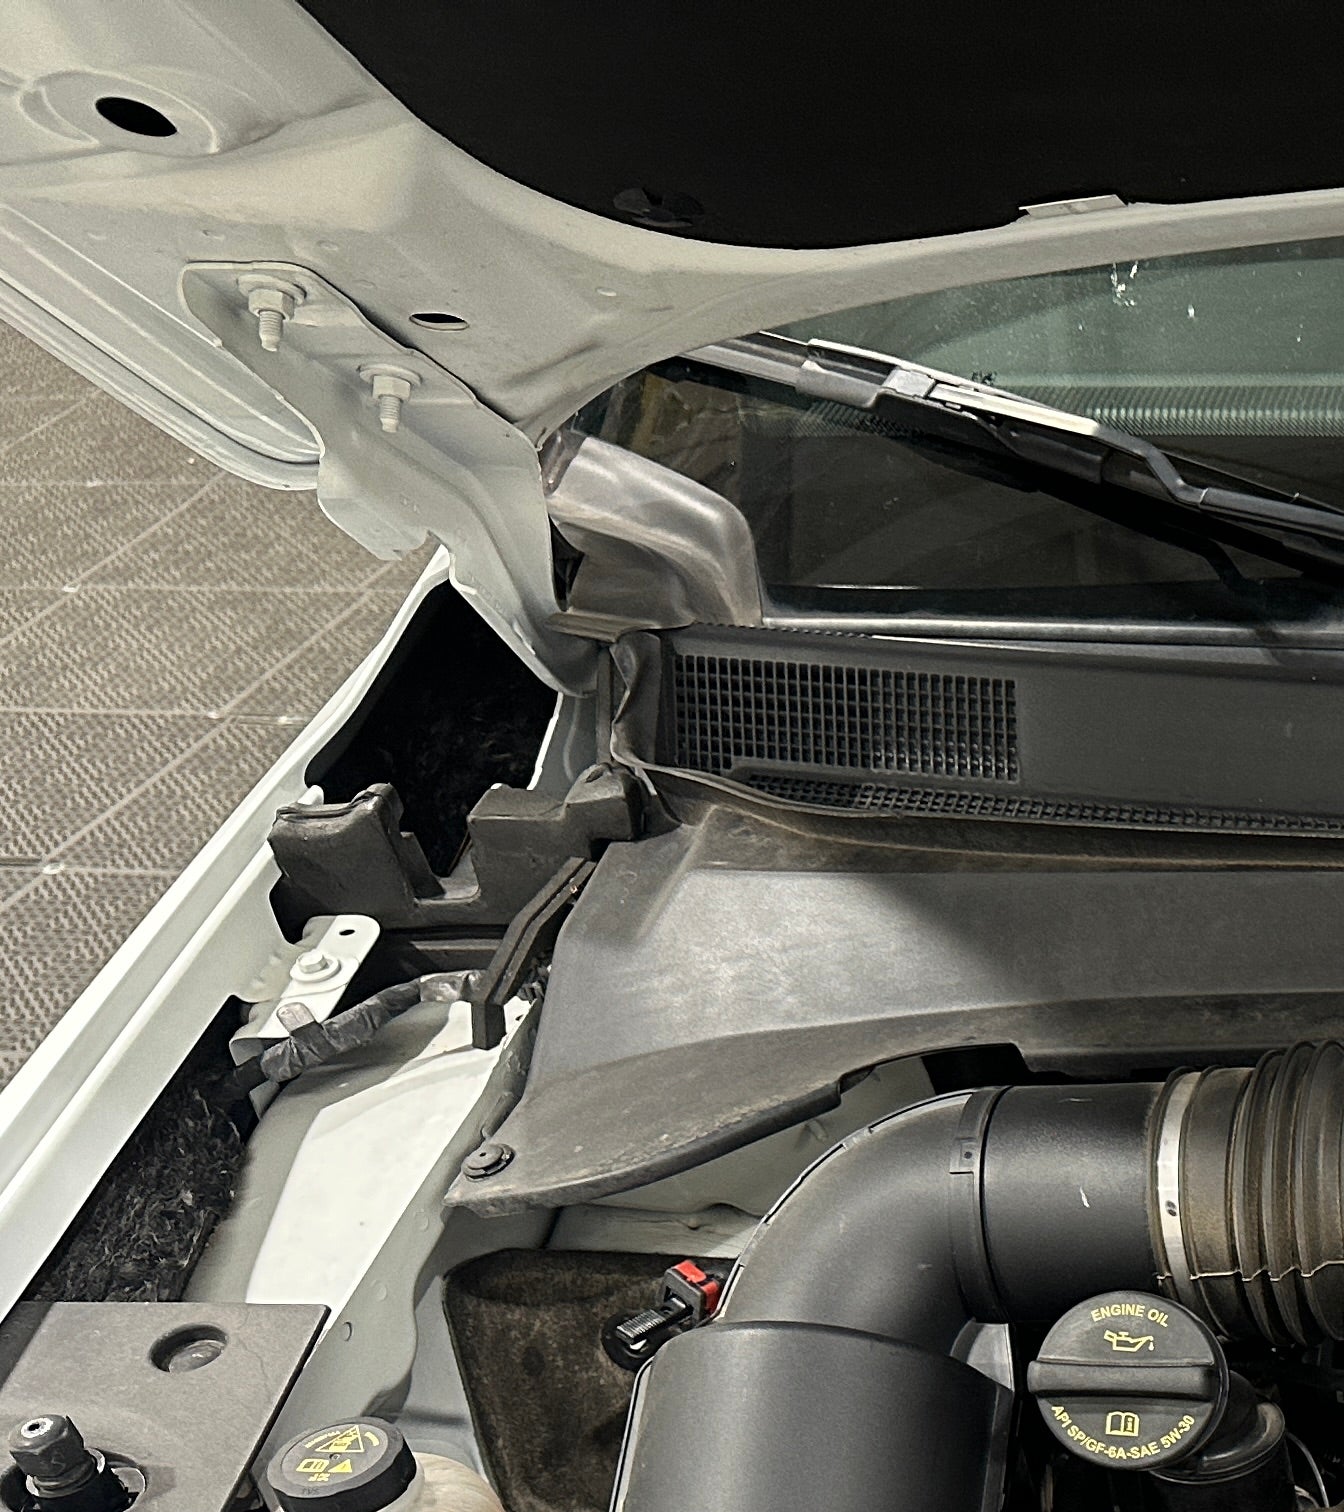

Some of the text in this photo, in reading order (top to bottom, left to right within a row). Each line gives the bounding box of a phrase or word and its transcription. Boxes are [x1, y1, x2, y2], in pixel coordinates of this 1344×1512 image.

[1091, 1303, 1169, 1327] ENGINE OIL
[1051, 1405, 1195, 1460] API SP/GF-6A-SAE 5W-30
